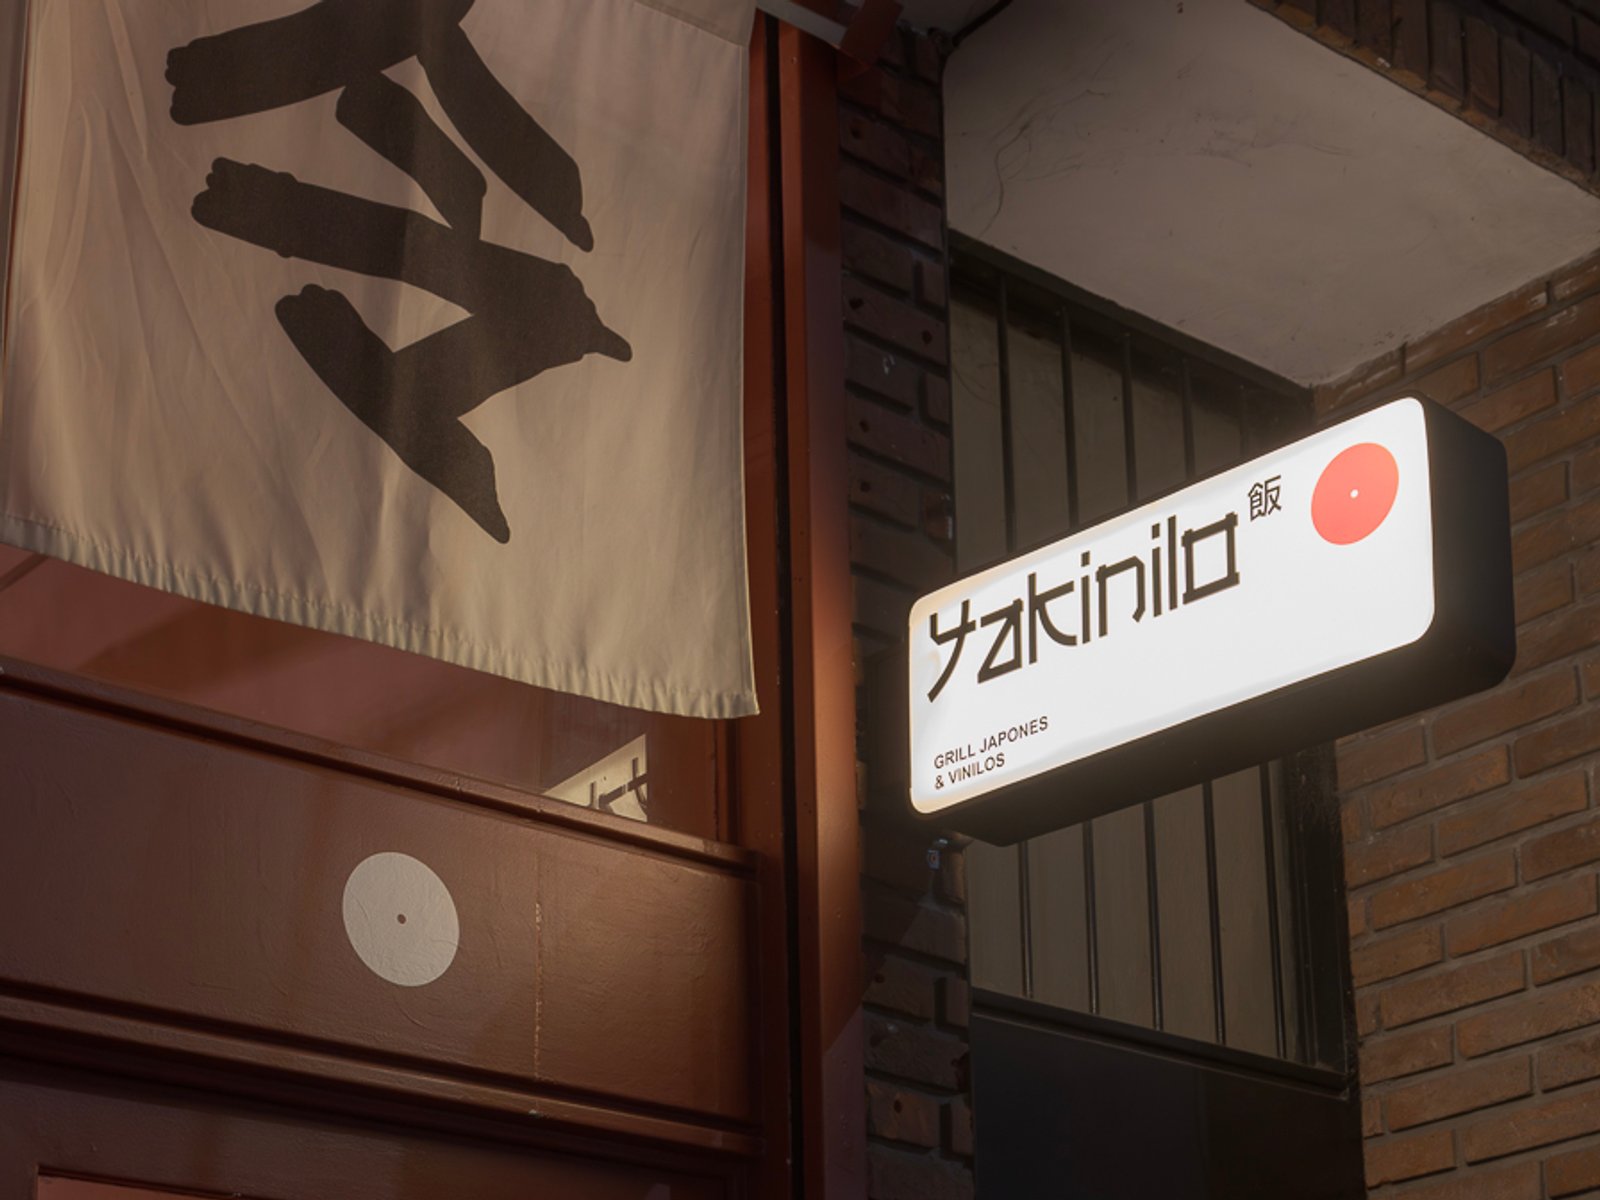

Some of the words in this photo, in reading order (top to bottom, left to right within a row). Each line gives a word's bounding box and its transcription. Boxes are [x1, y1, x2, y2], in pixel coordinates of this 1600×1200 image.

[1247, 474, 1282, 522] 飯
[933, 744, 976, 769] GRILL
[979, 715, 1049, 753] JAPONES
[934, 775, 945, 790] &
[948, 752, 1006, 784] VINILOS
